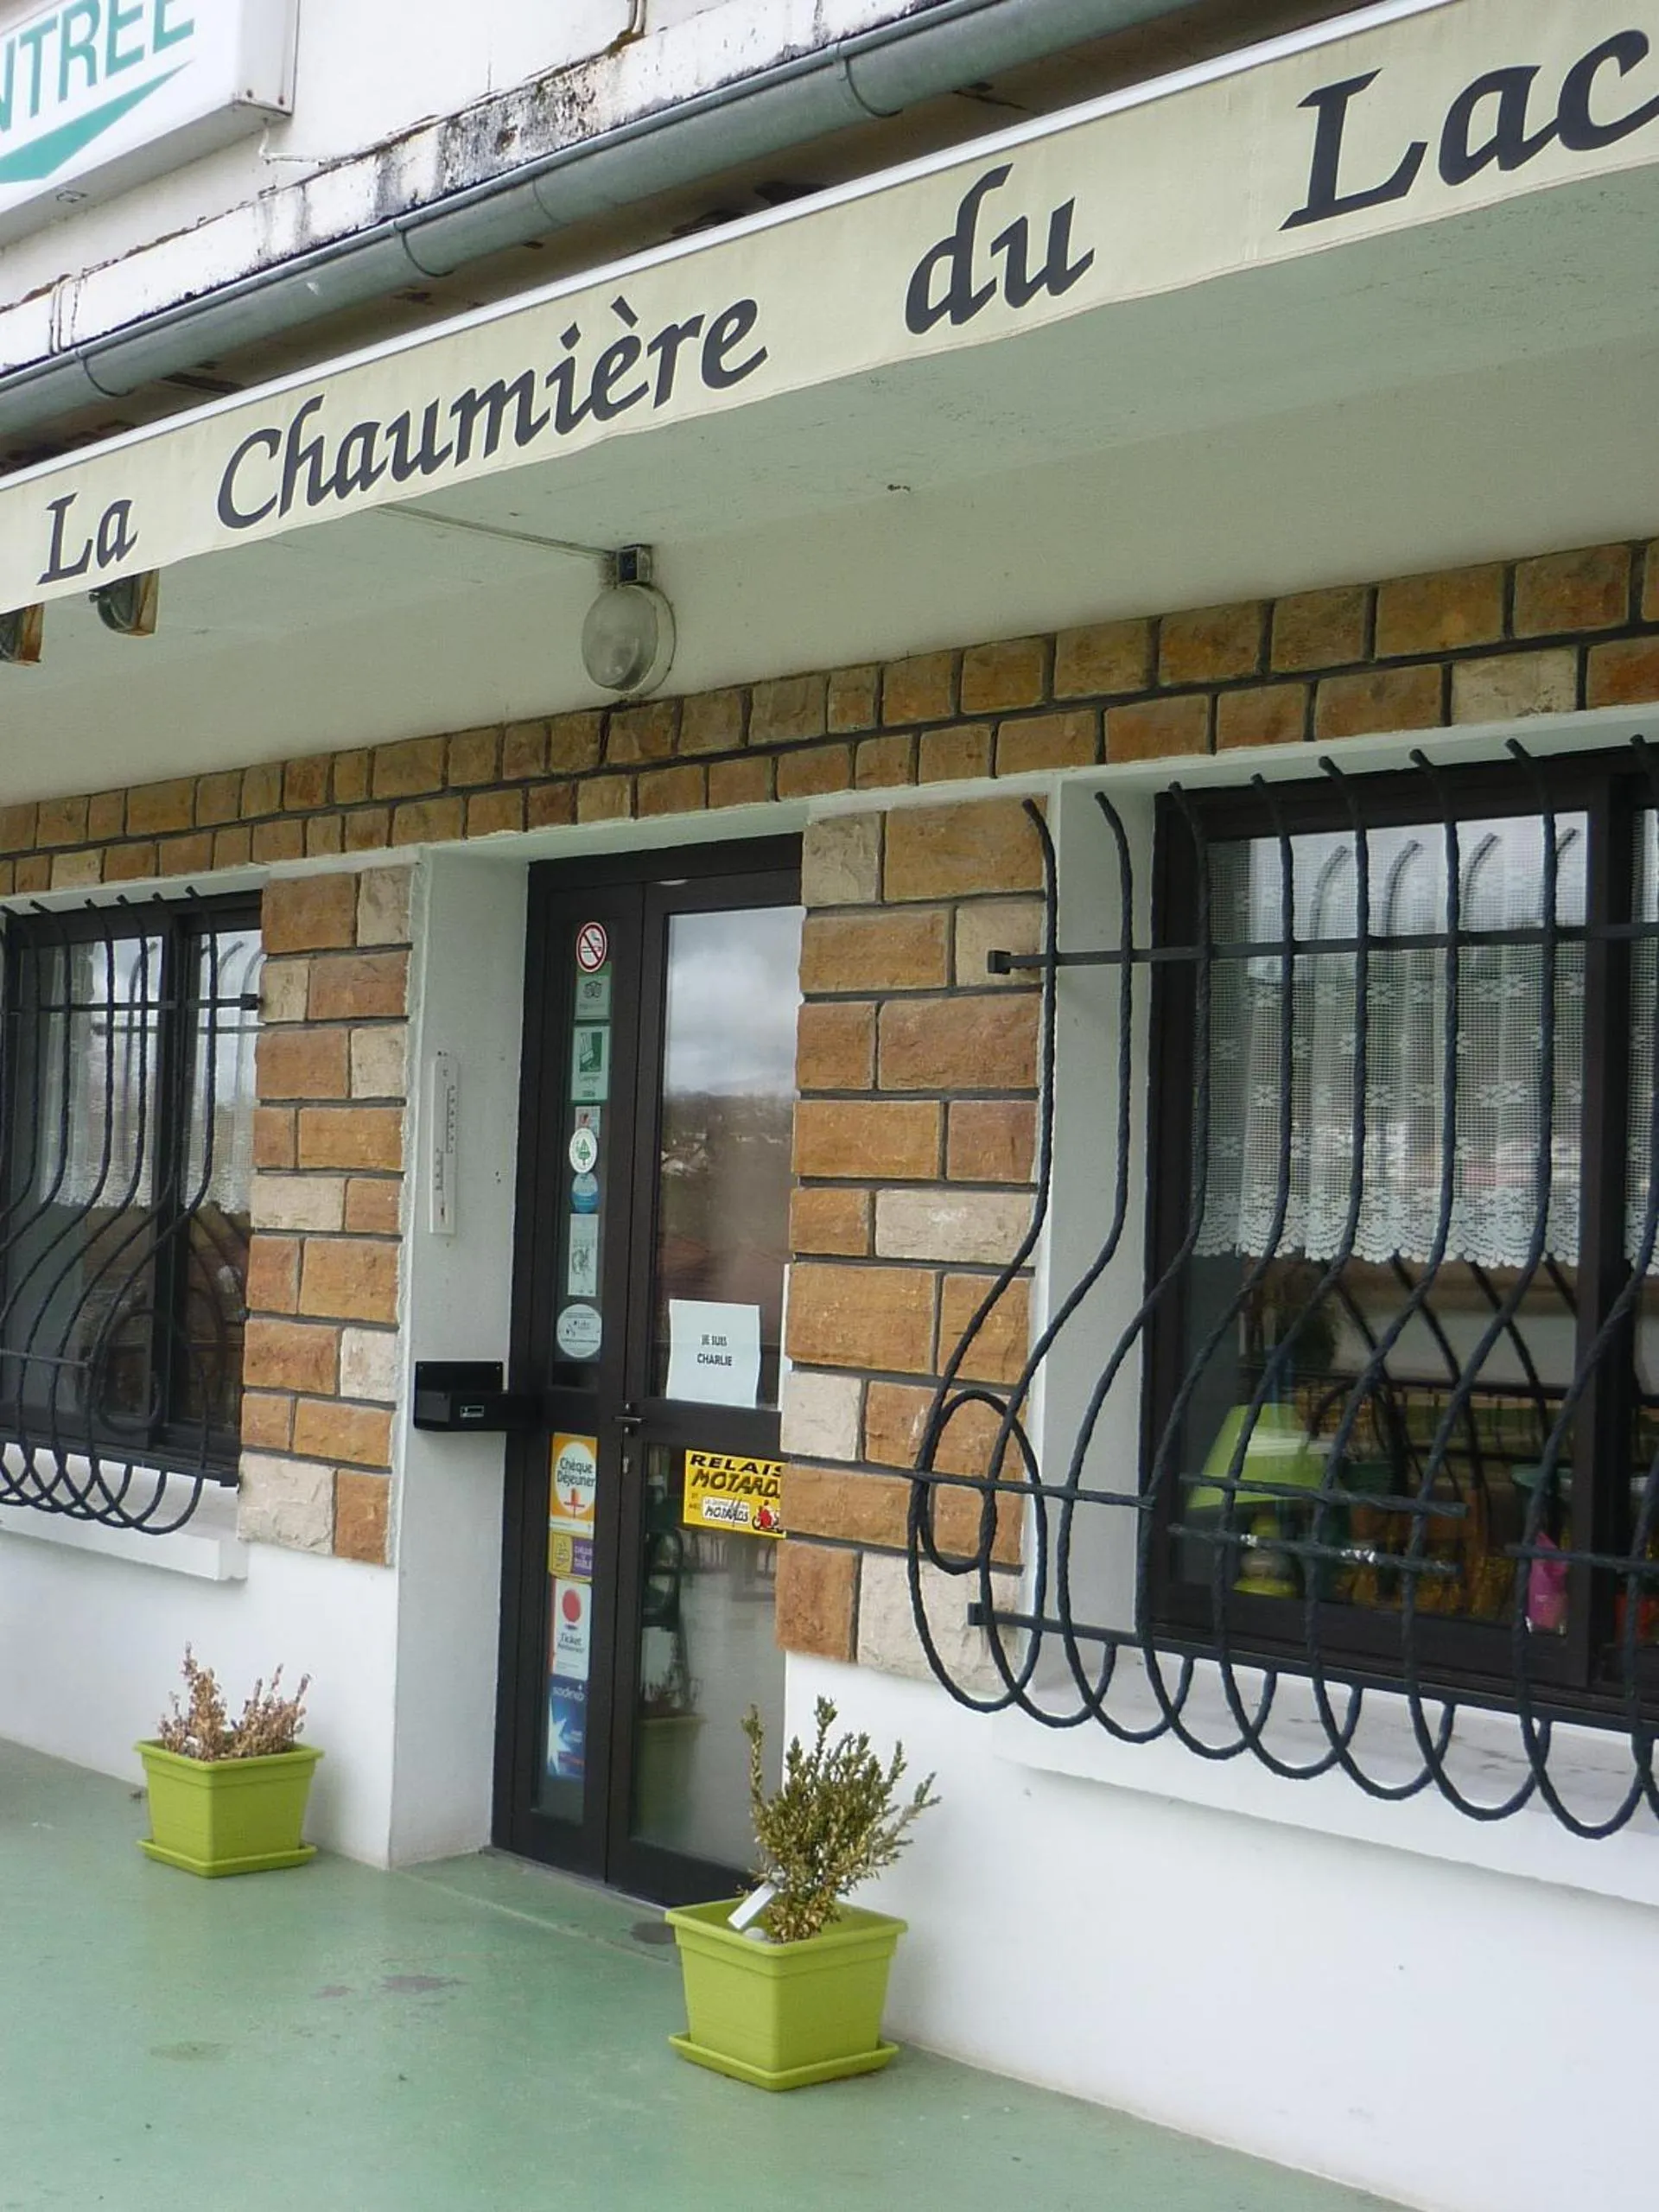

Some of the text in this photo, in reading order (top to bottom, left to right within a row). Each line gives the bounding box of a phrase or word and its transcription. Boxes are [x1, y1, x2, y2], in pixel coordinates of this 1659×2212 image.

[39, 29, 1659, 585] La Chaumière du Lac
[696, 1352, 733, 1367] CHARLIE
[691, 1468, 781, 1498] MOTARD
